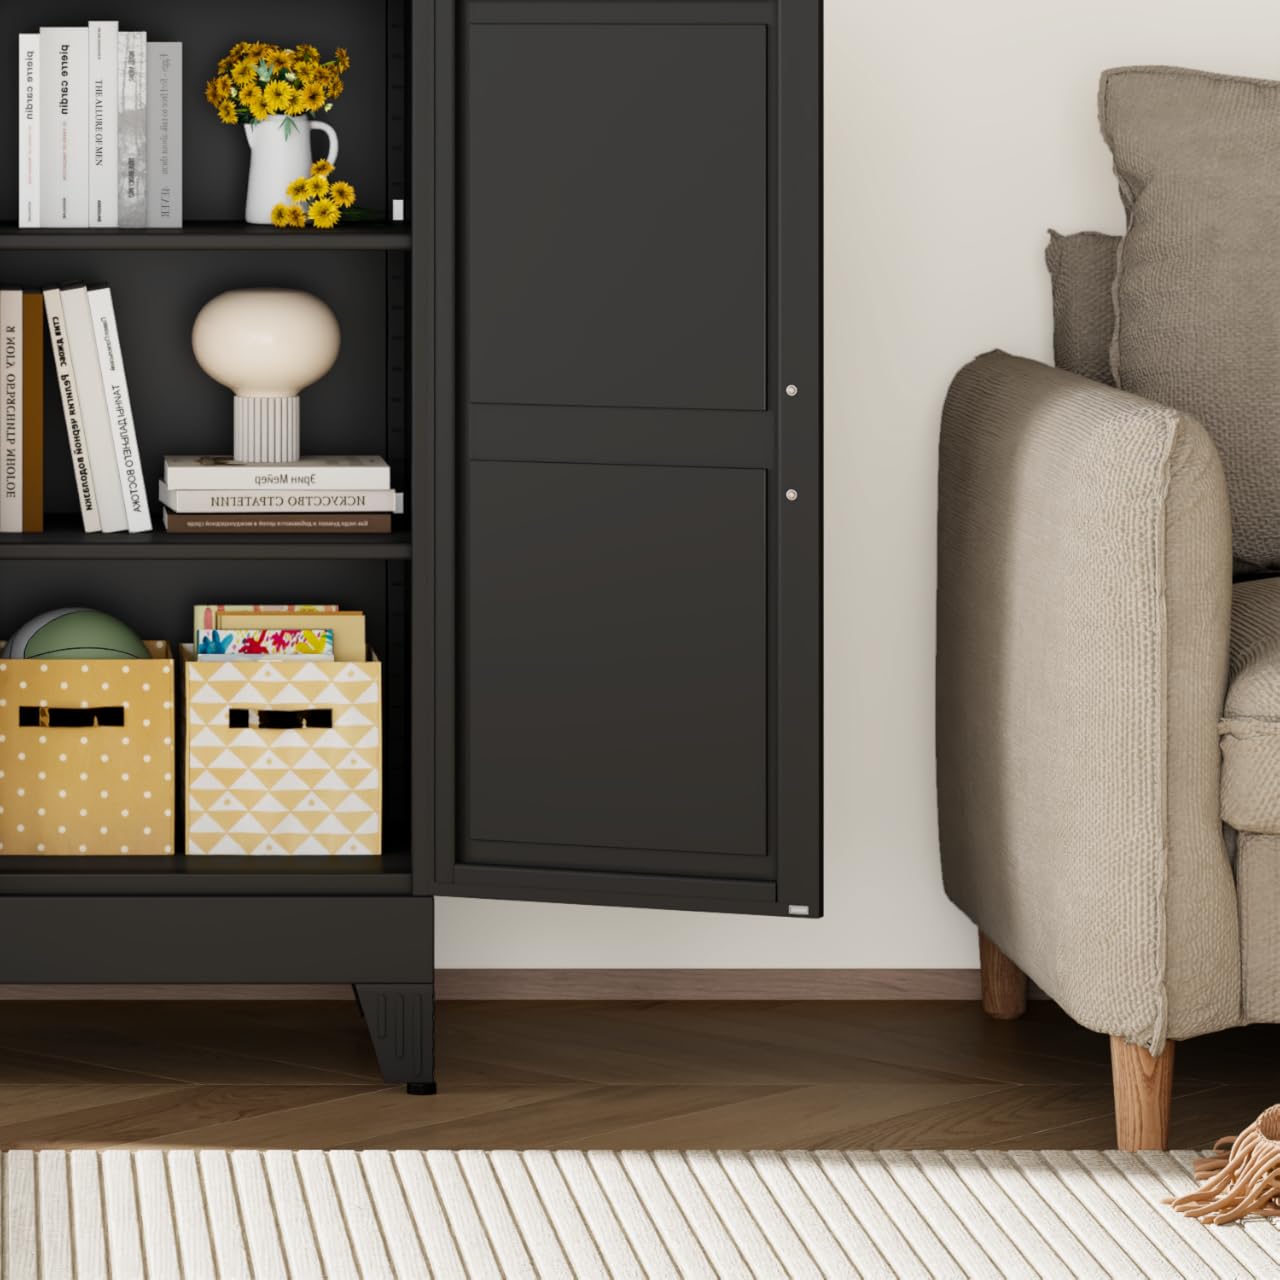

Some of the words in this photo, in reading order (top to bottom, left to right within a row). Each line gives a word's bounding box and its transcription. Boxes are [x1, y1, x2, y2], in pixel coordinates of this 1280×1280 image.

[95, 80, 103, 96] THE
[95, 99, 103, 132] ALLURE
[95, 133, 103, 145] OF
[95, 147, 103, 166] MEN
